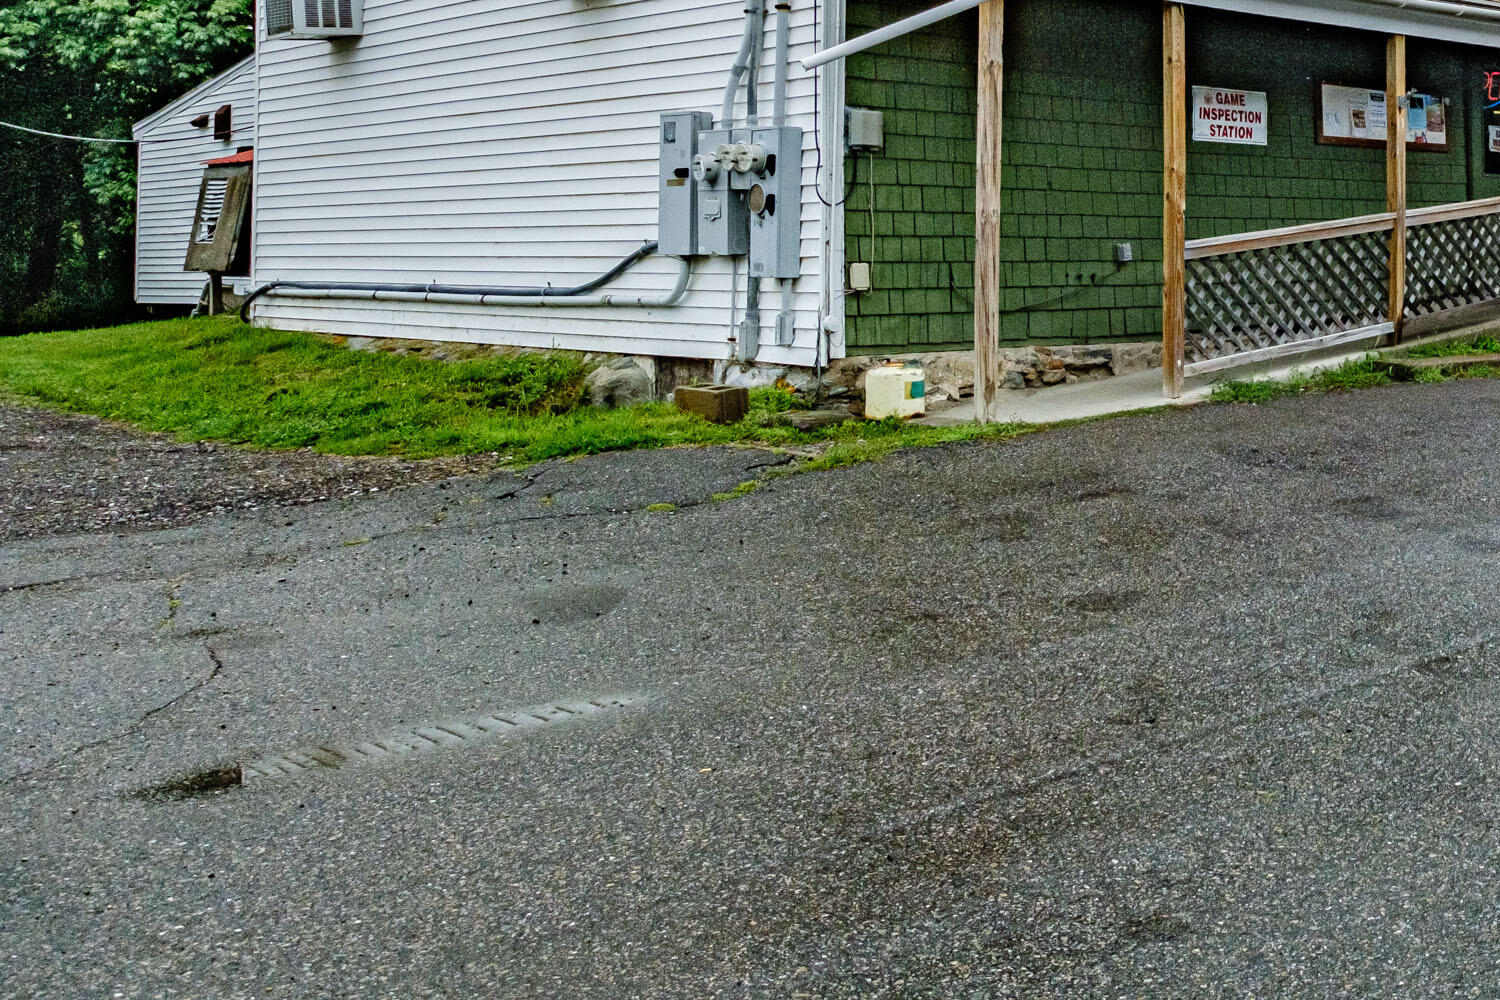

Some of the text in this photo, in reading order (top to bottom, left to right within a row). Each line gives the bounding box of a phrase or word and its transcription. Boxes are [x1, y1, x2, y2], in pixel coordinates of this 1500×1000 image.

[1216, 92, 1246, 106] GAME
[1199, 107, 1262, 124] INSPECTION
[1210, 124, 1253, 140] STATION
